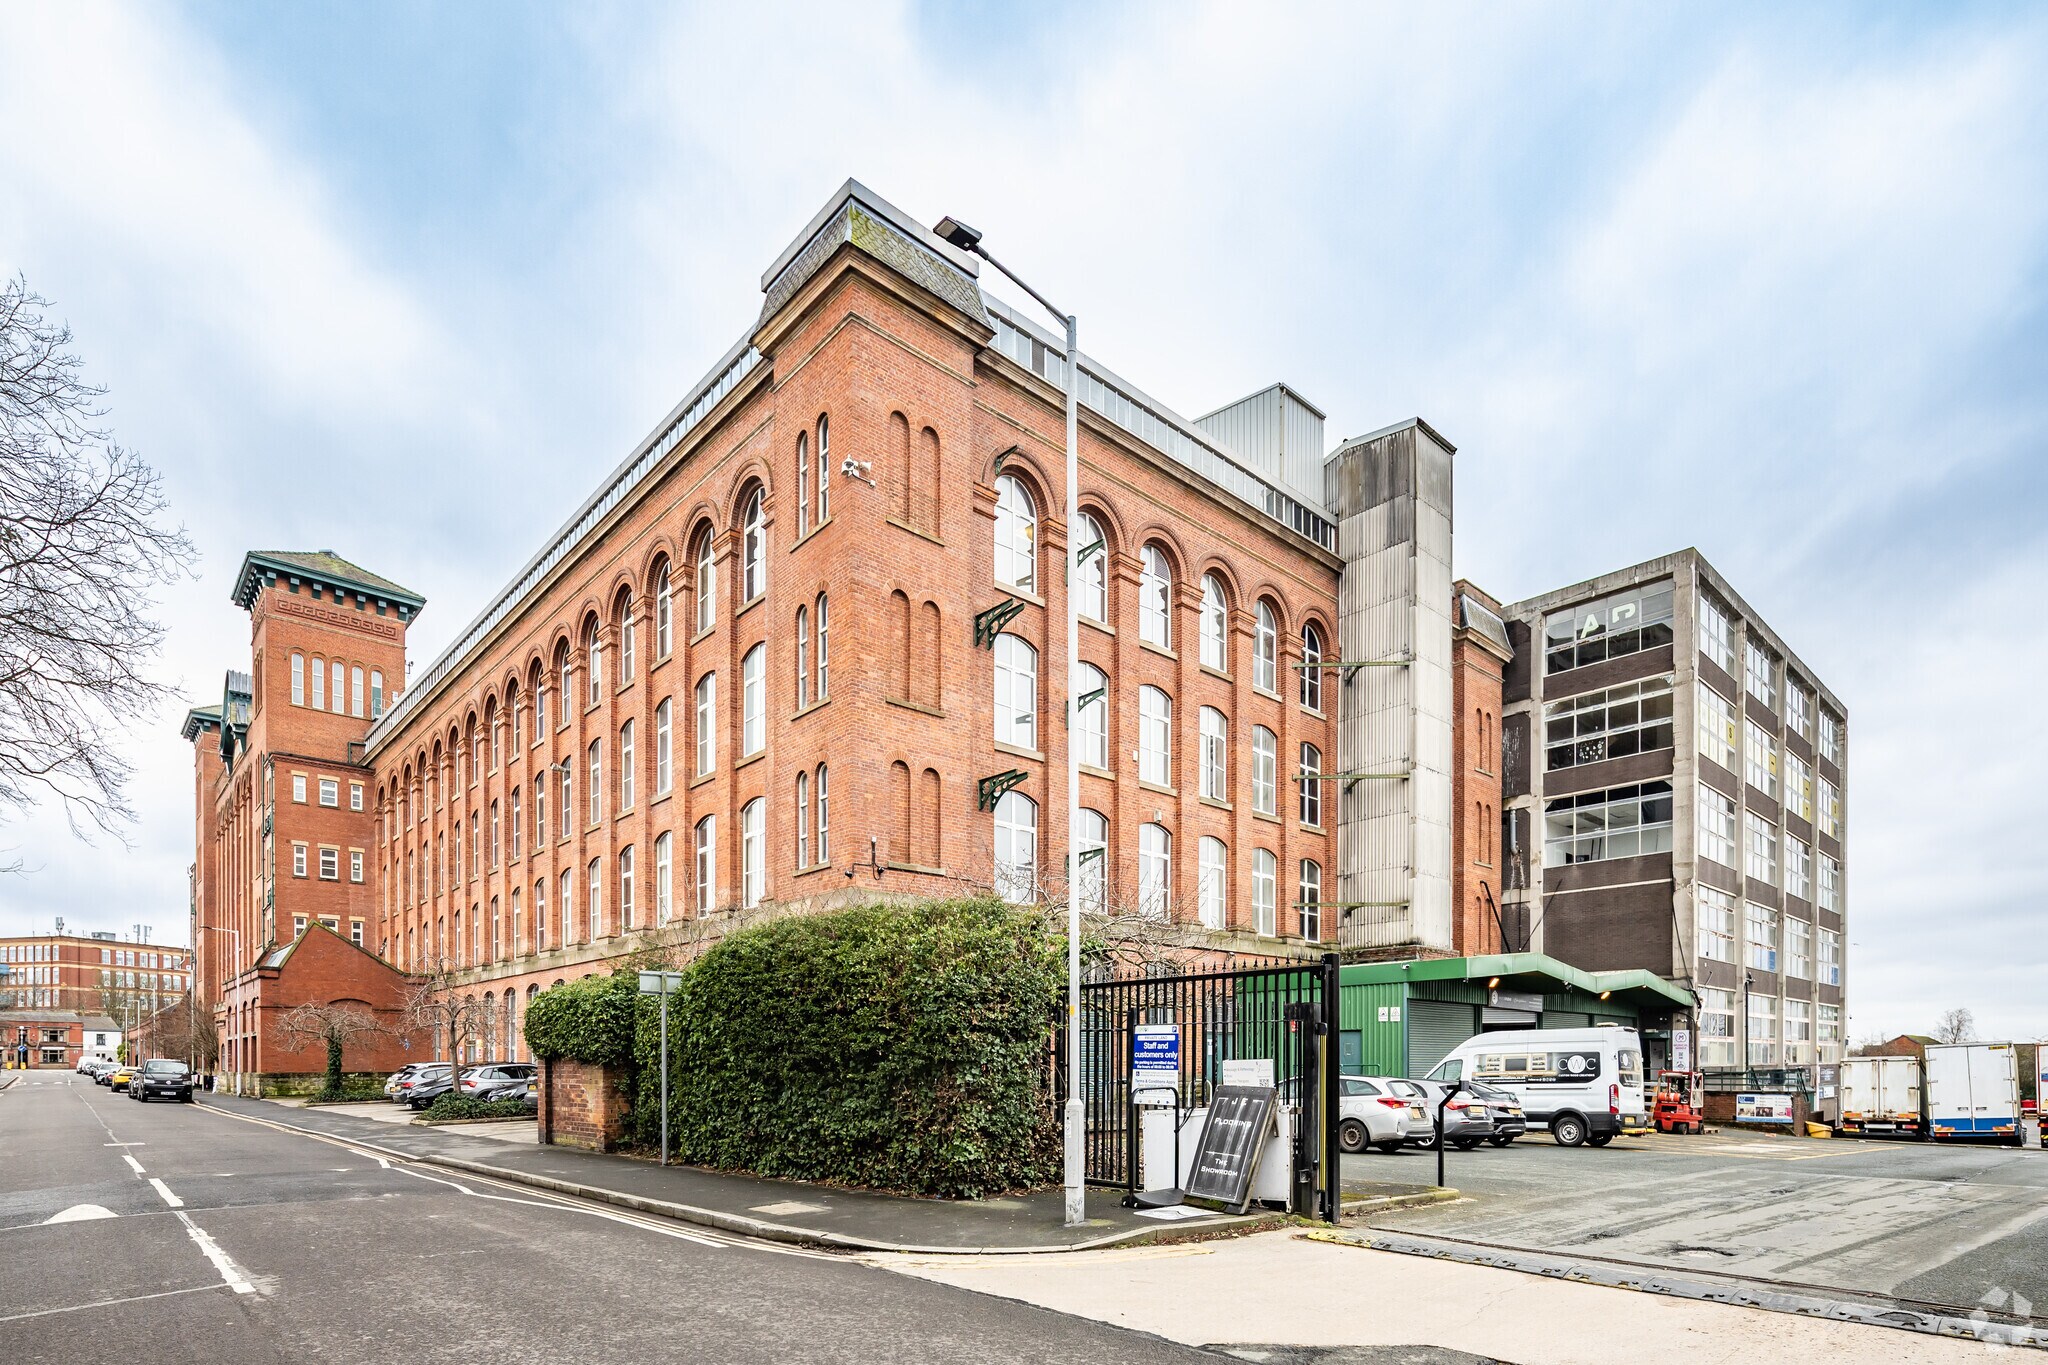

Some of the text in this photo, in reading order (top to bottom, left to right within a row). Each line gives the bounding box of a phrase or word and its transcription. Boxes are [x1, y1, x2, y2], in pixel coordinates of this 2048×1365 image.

[1165, 1051, 1178, 1060] only
[1558, 1057, 1596, 1071] CWC
[1214, 1117, 1252, 1128] FLOORING
[1215, 1158, 1228, 1166] THE
[1201, 1166, 1238, 1176] SHOWROOM
